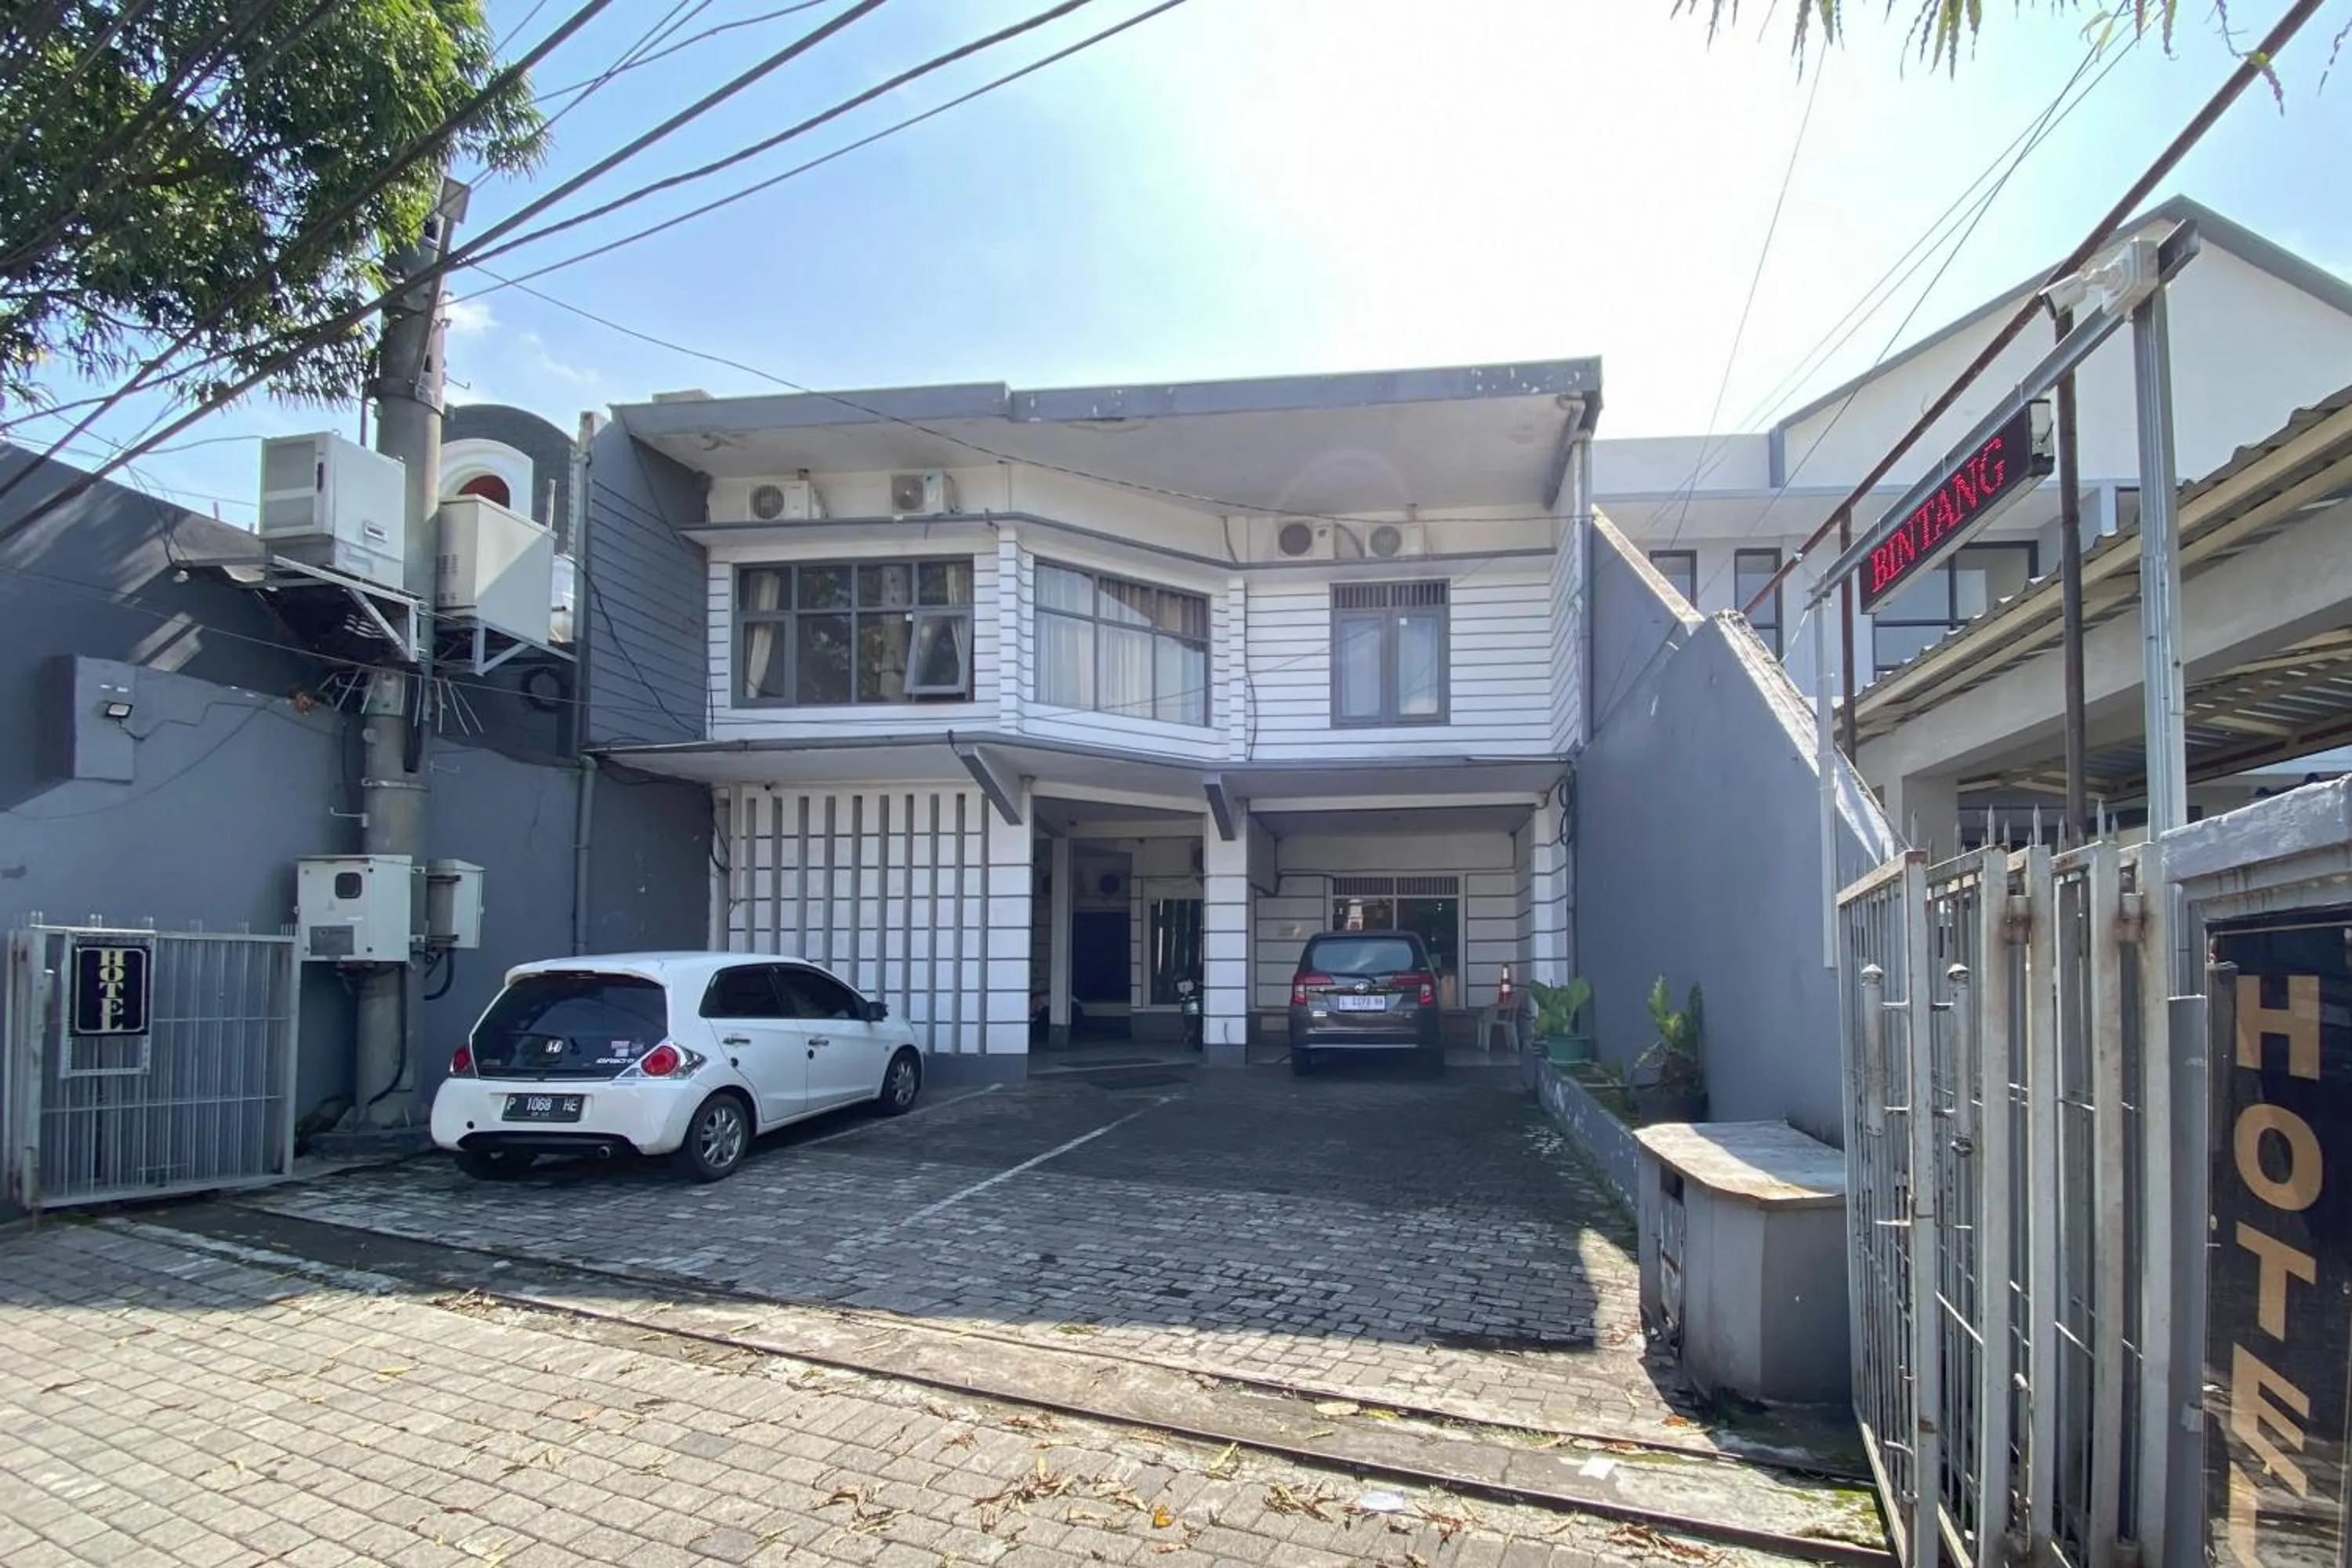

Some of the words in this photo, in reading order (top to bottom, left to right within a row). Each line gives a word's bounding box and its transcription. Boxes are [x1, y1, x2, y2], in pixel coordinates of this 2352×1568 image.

[1870, 435, 2006, 593] BINTANG
[99, 949, 125, 1030] HOTEL
[506, 1098, 516, 1111] P
[526, 1097, 553, 1111] 1068
